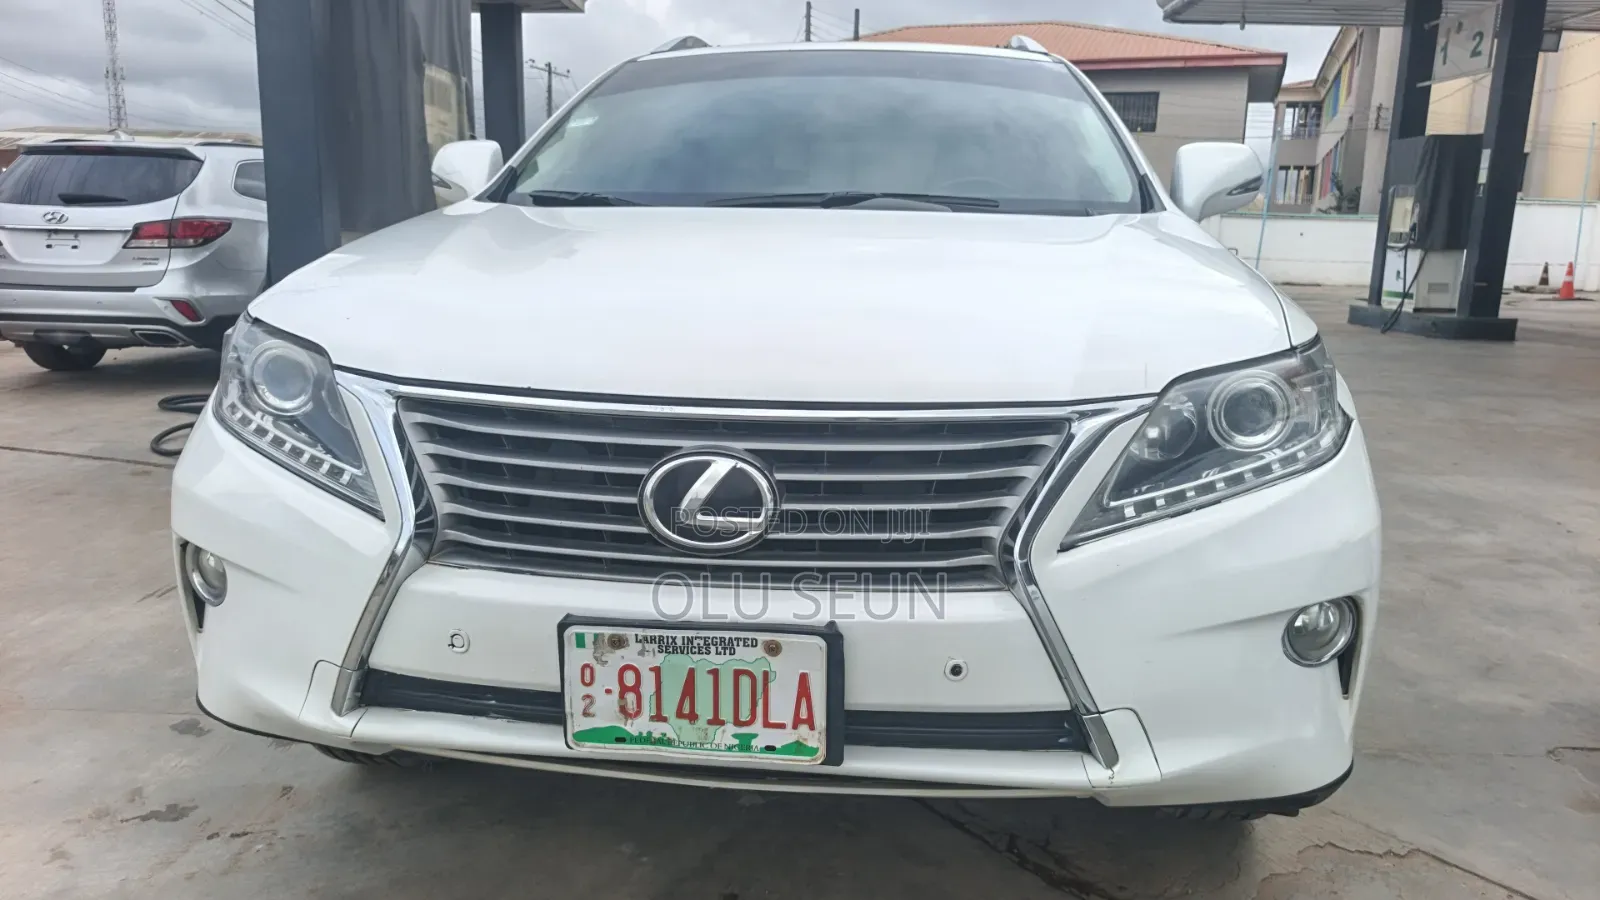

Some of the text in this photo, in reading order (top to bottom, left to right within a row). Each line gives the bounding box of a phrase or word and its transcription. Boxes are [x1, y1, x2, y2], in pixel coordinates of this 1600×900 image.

[1469, 31, 1485, 58] 2
[682, 636, 758, 648] INTEGRATED
[657, 645, 736, 656] SERVICES LTD
[724, 742, 760, 751] NIGERIA
